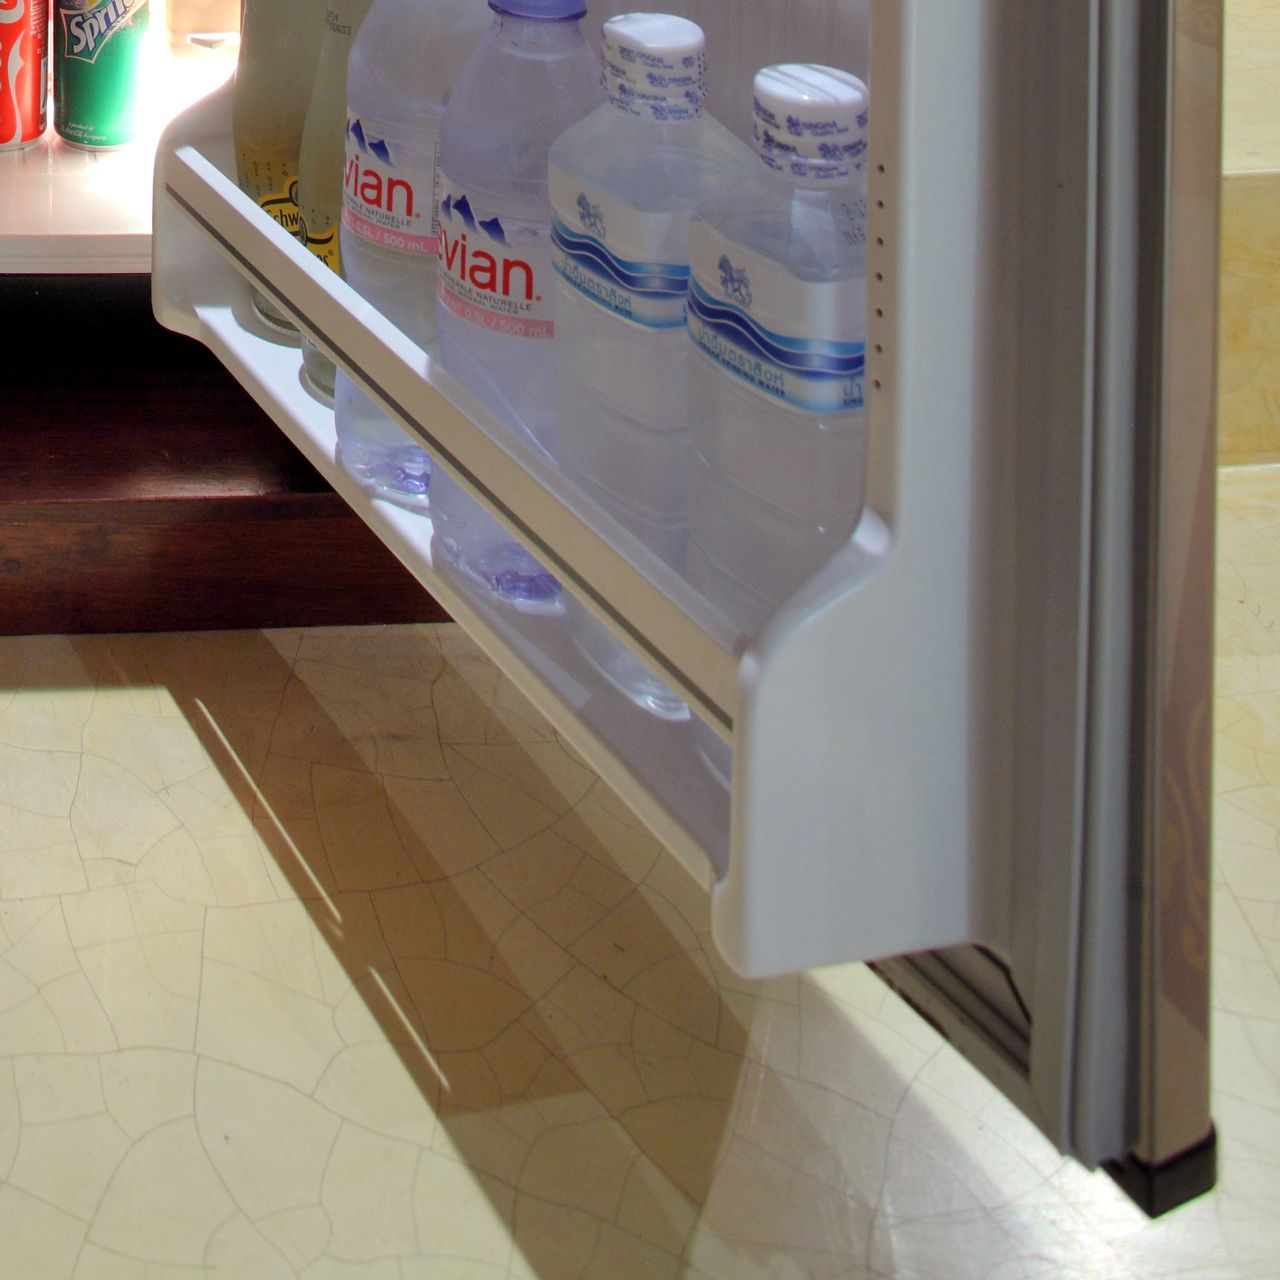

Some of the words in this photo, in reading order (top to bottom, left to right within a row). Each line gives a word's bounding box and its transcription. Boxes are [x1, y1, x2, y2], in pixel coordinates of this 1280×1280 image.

[343, 151, 414, 218] vian
[365, 207, 412, 228] NATURELLE
[383, 232, 404, 249] 500
[407, 240, 428, 253] mL
[438, 221, 534, 301] vian
[476, 291, 532, 312] NATURELLE
[490, 303, 520, 315] WATER
[498, 320, 525, 336] 500
